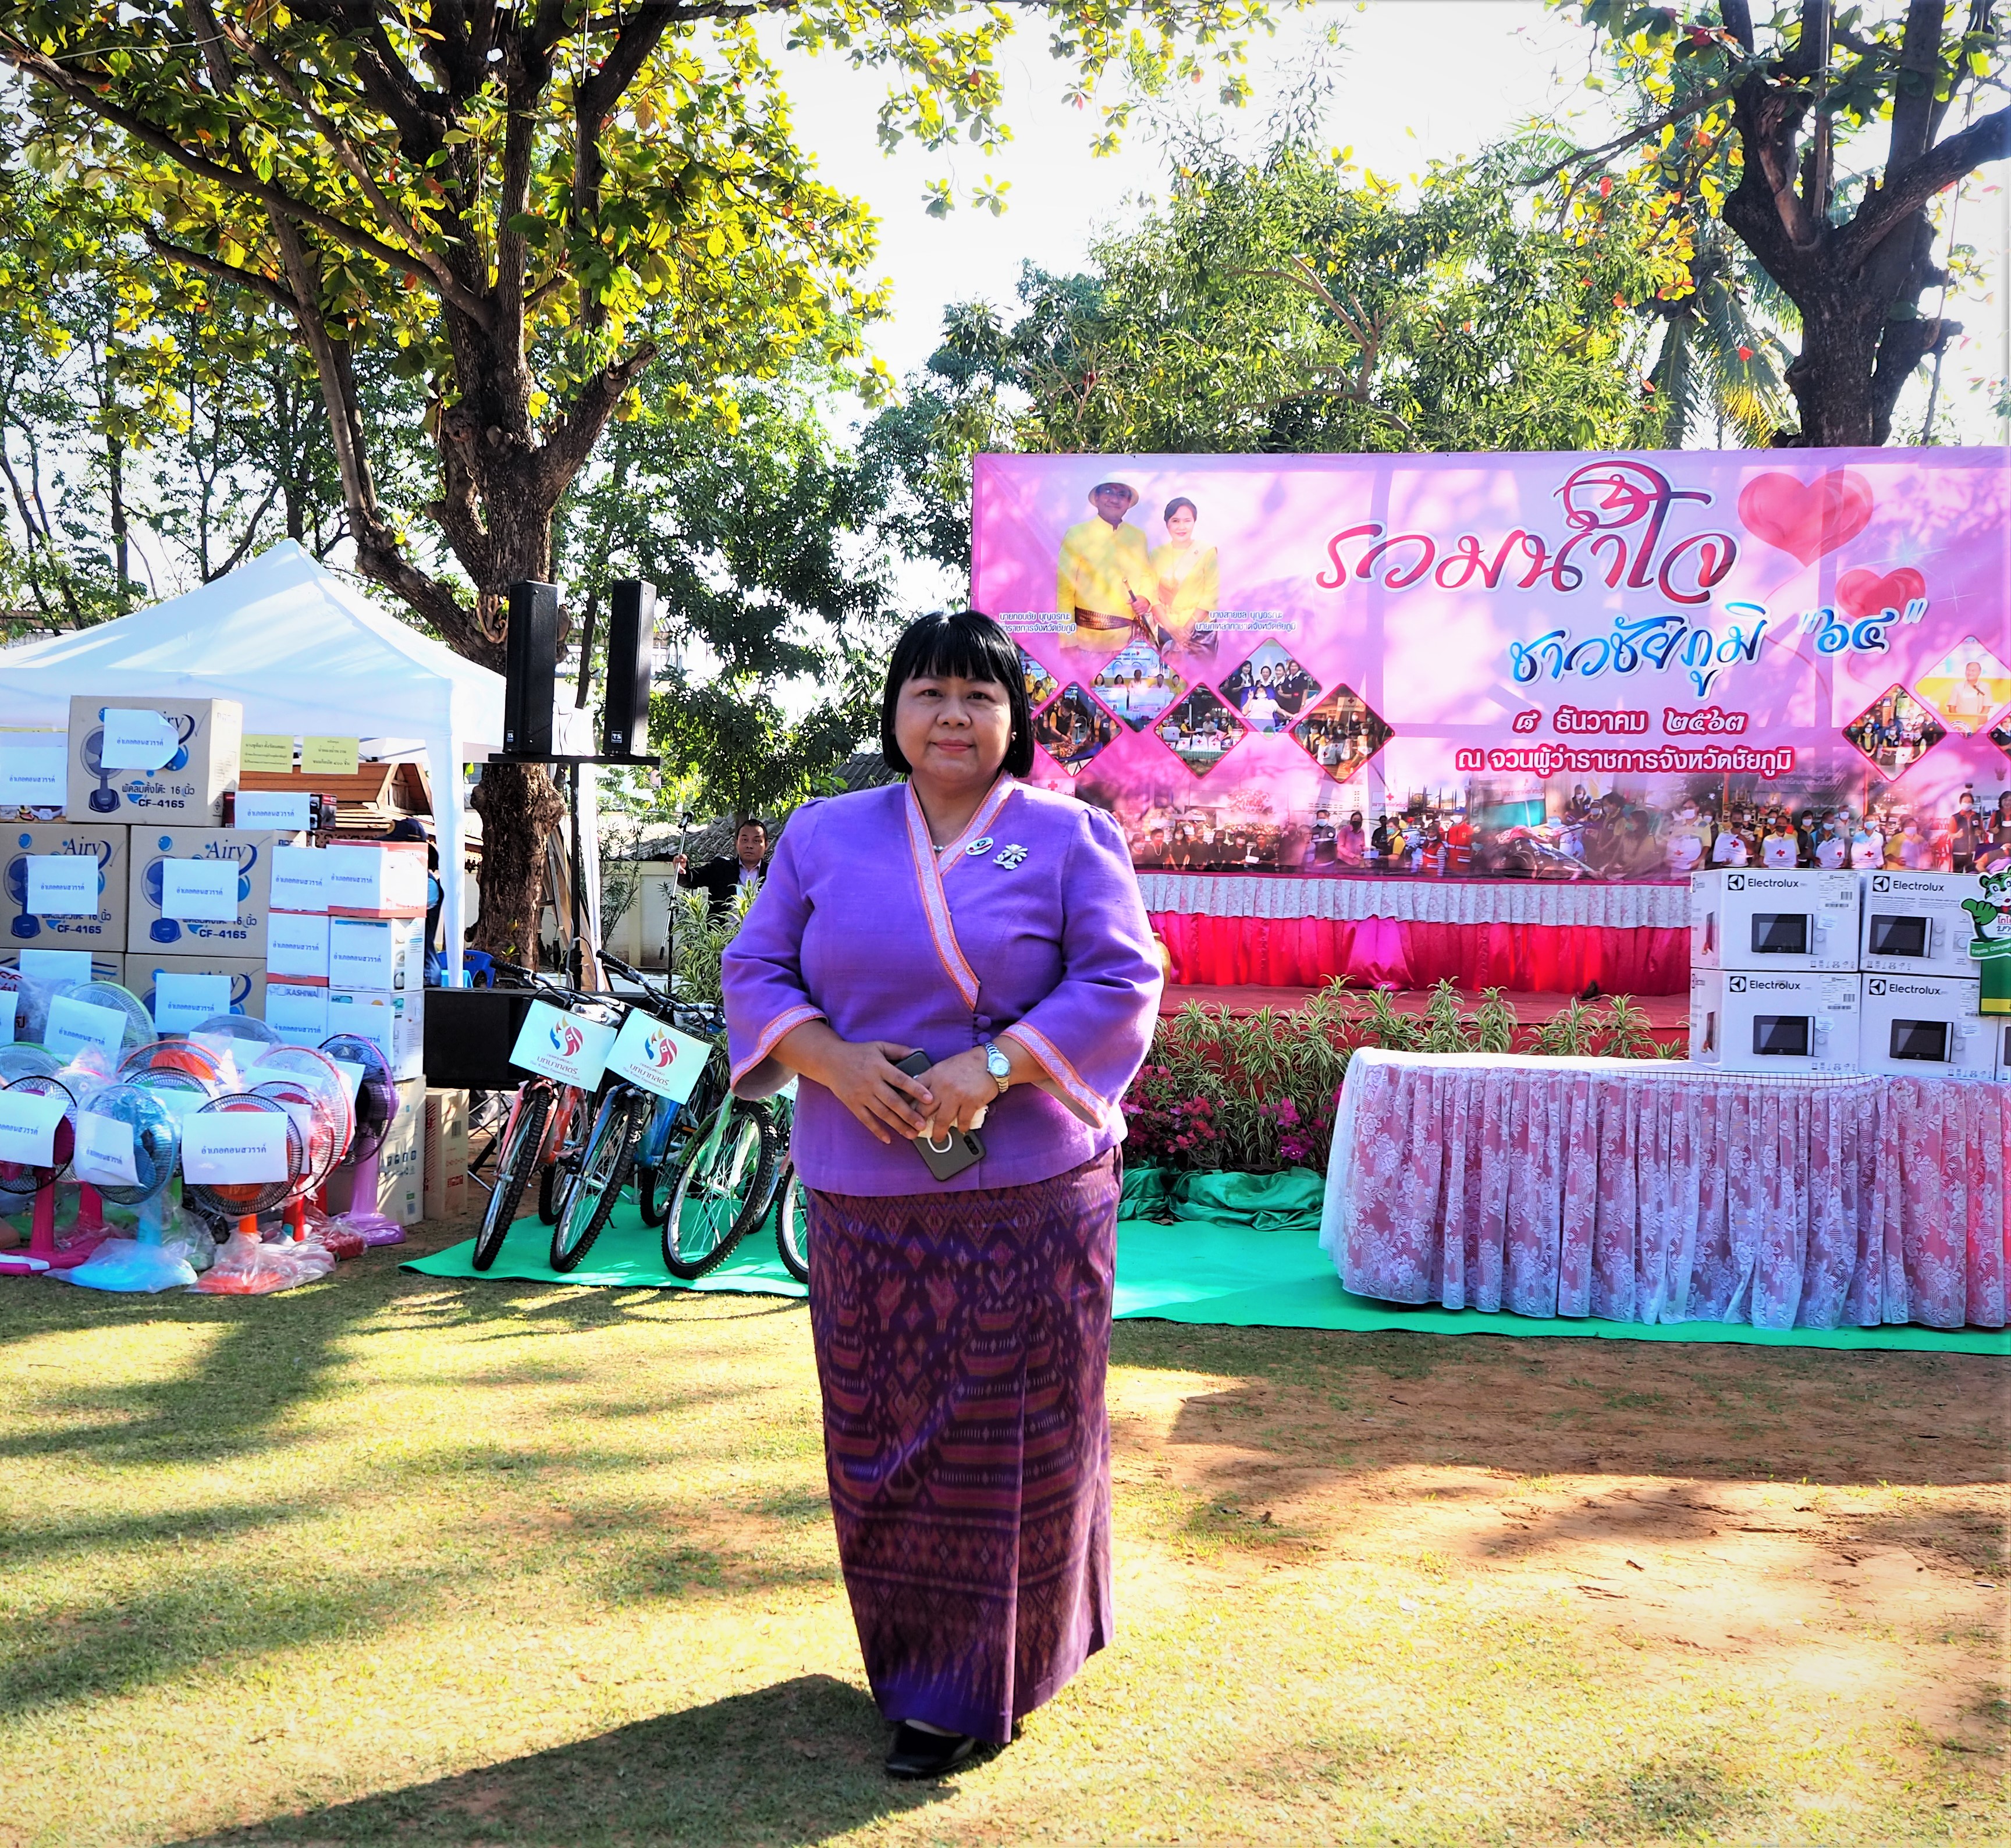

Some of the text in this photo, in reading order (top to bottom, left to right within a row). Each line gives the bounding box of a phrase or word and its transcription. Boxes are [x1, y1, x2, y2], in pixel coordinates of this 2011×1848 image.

[1316, 460, 1737, 603] รวมน้ำใจ
[1510, 602, 1768, 698] ชาวชัยภูมิ
[1515, 708, 1746, 731] ๘ ธันวาคม ๒๕๖๓
[1458, 747, 1791, 776] ณ จวนผู้ว่าราชการจังหวัดชัยภูมิ
[122, 781, 196, 795] พัดลมตั้งโต๊ะ 16 นิ้ว
[138, 799, 185, 808] CF-4165
[63, 836, 102, 856] Airy
[205, 839, 247, 861] Airy
[1747, 878, 1799, 888] Electrolux
[1892, 880, 1945, 892] Electrolux
[57, 925, 102, 934] CF-4165
[199, 929, 247, 939] CF-4165
[1749, 980, 1801, 990] Electrolux
[1889, 983, 1941, 995] Electrolux
[201, 1145, 267, 1156] อำเภอคอนสวรรค์
